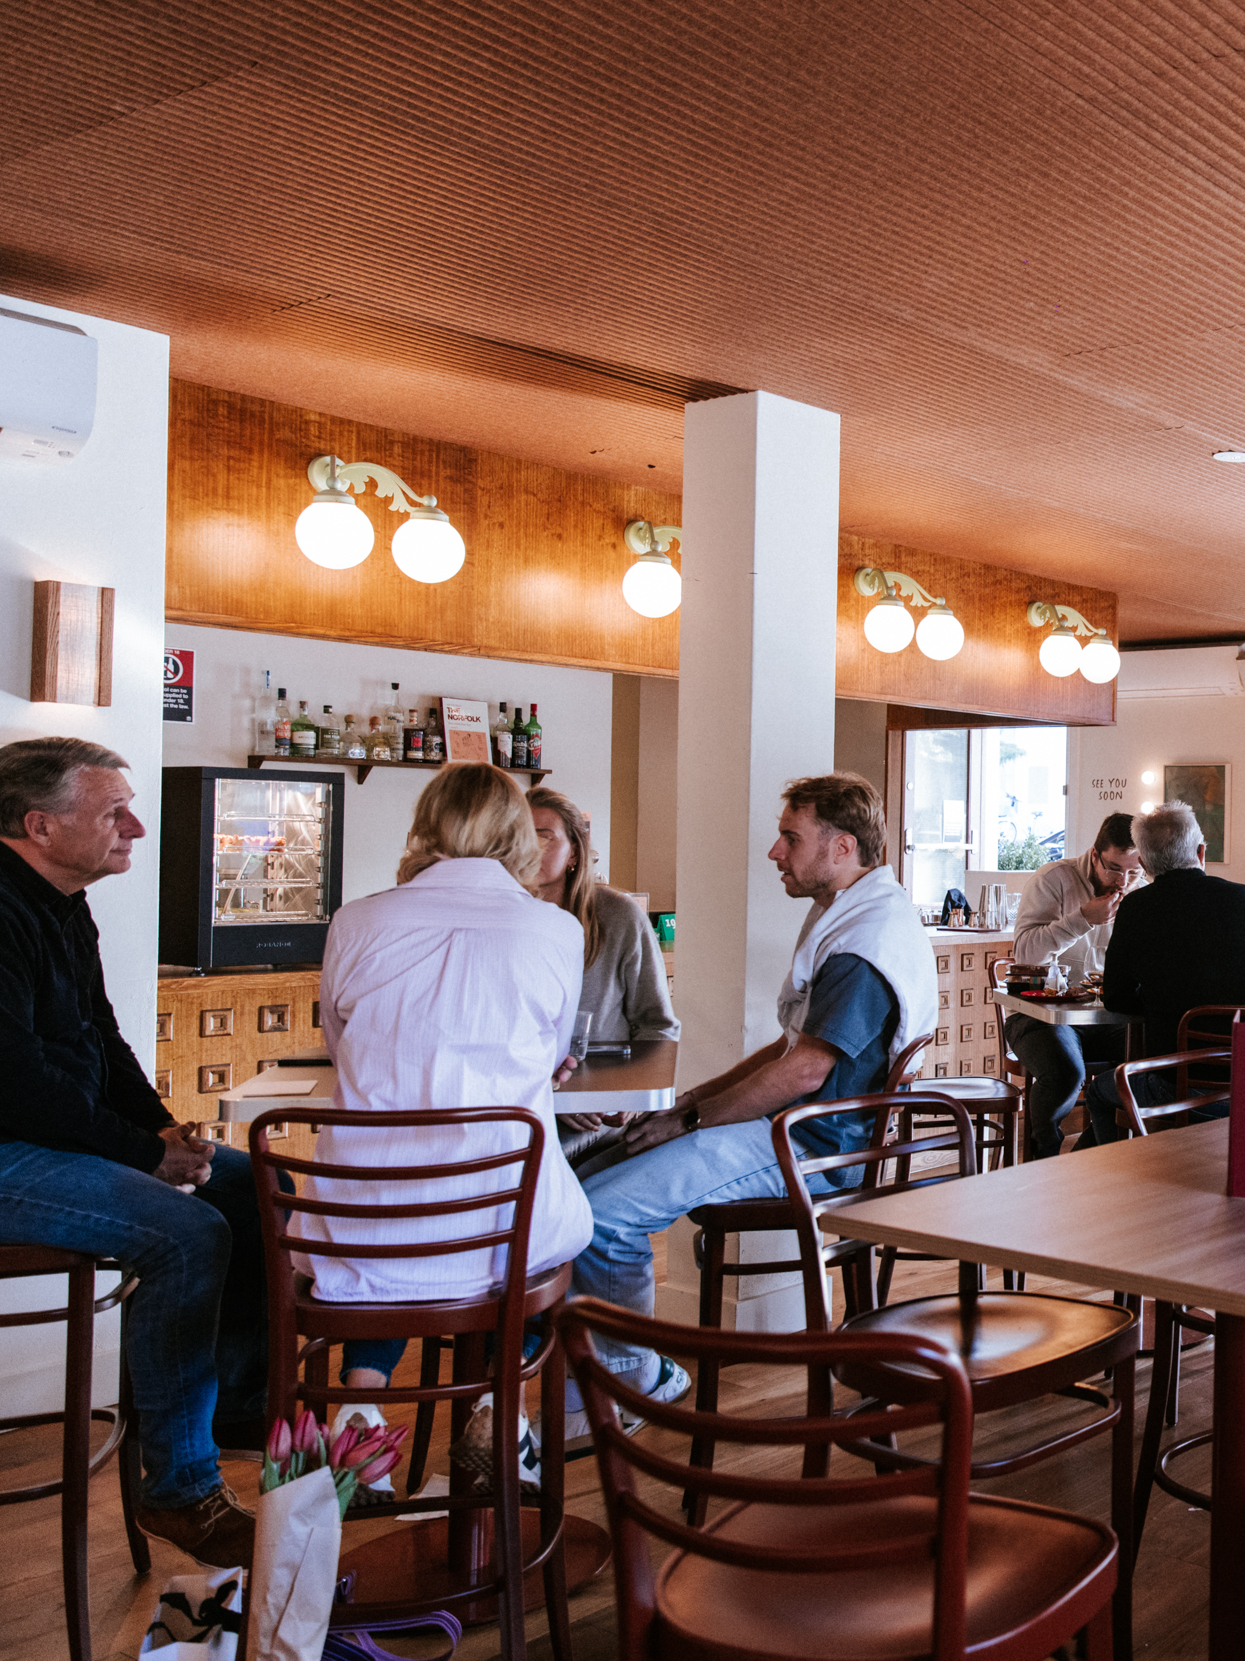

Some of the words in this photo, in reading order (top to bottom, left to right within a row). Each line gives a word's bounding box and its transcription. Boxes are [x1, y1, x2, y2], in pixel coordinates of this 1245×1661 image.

[447, 714, 481, 723] NORFOLK
[1091, 778, 1104, 789] SEE
[1108, 777, 1128, 789] YOU
[1098, 790, 1123, 801] SOON
[665, 918, 676, 929] 19
